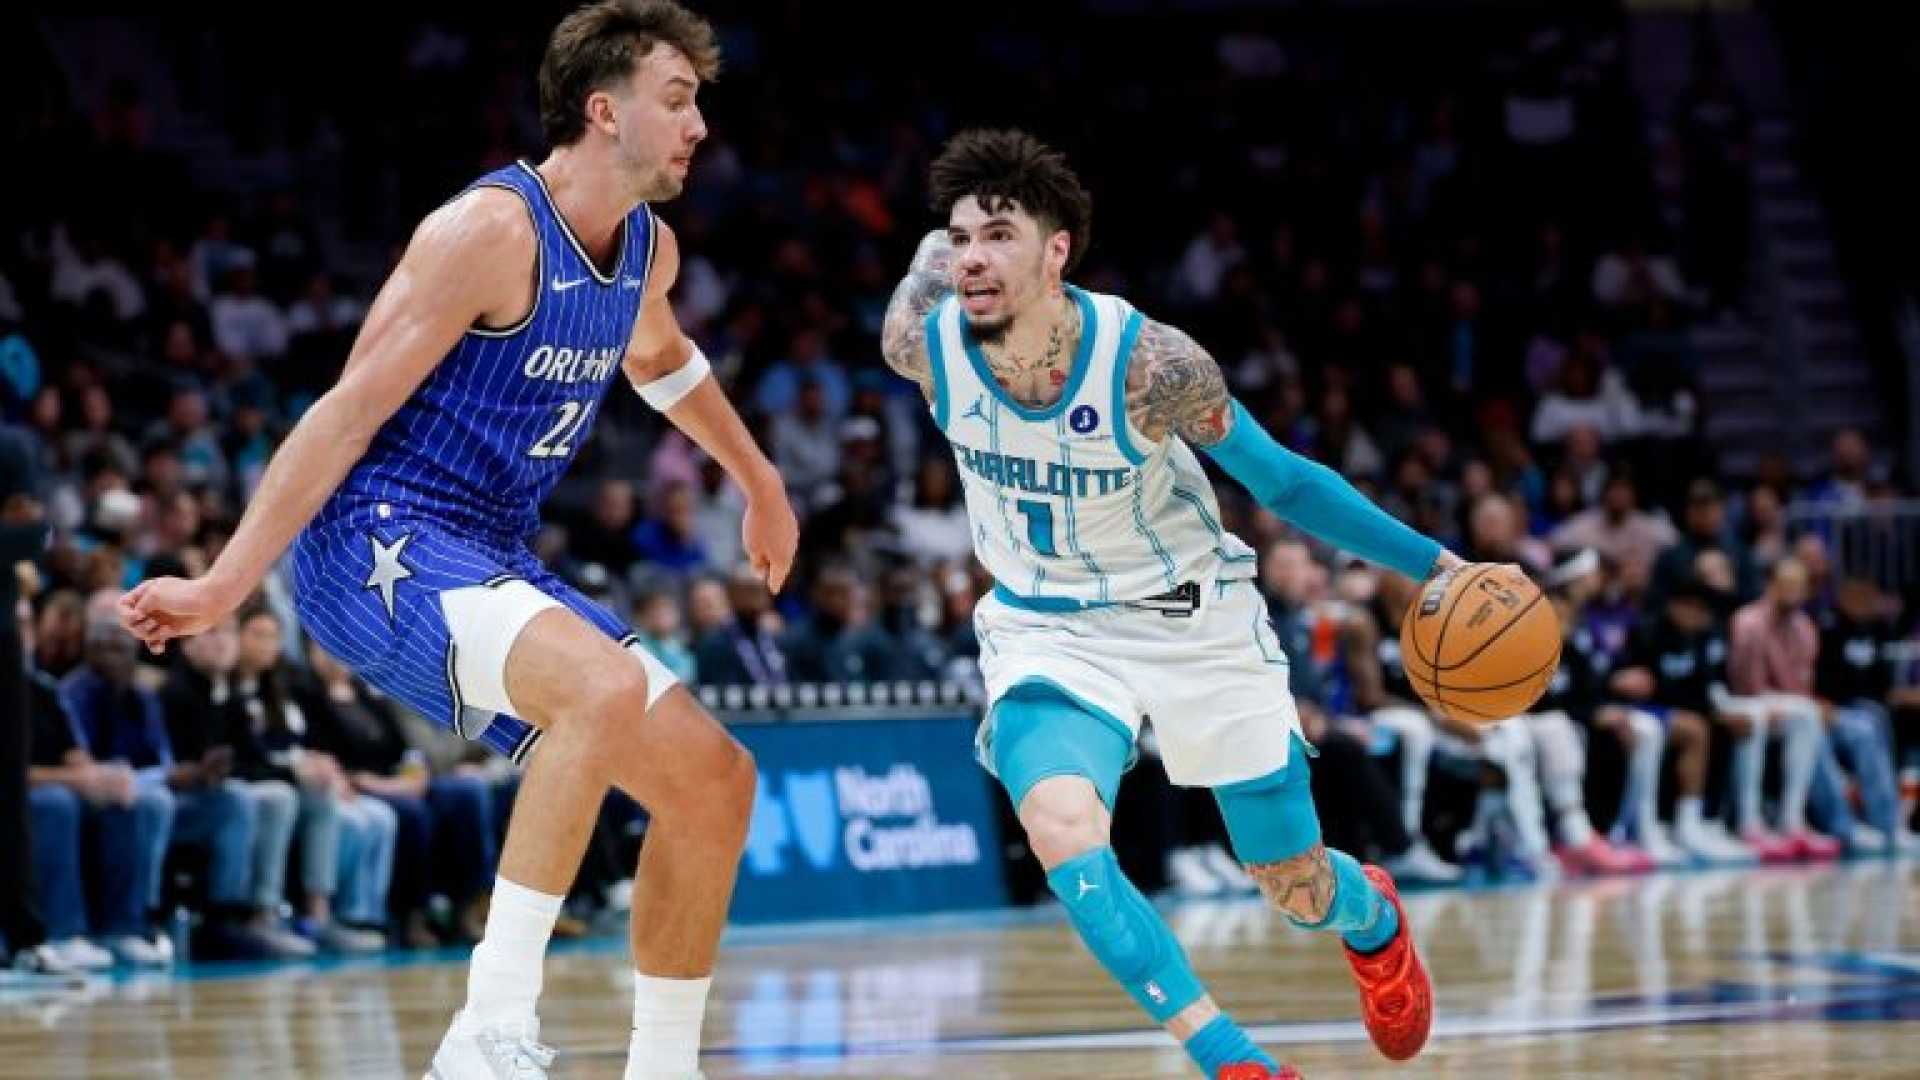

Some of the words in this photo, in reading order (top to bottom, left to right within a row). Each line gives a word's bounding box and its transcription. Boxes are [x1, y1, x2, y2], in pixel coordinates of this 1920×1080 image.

[525, 345, 621, 381] ORLAN
[1017, 500, 1057, 556] 1
[835, 763, 932, 816] North
[844, 815, 980, 869] Carolina
